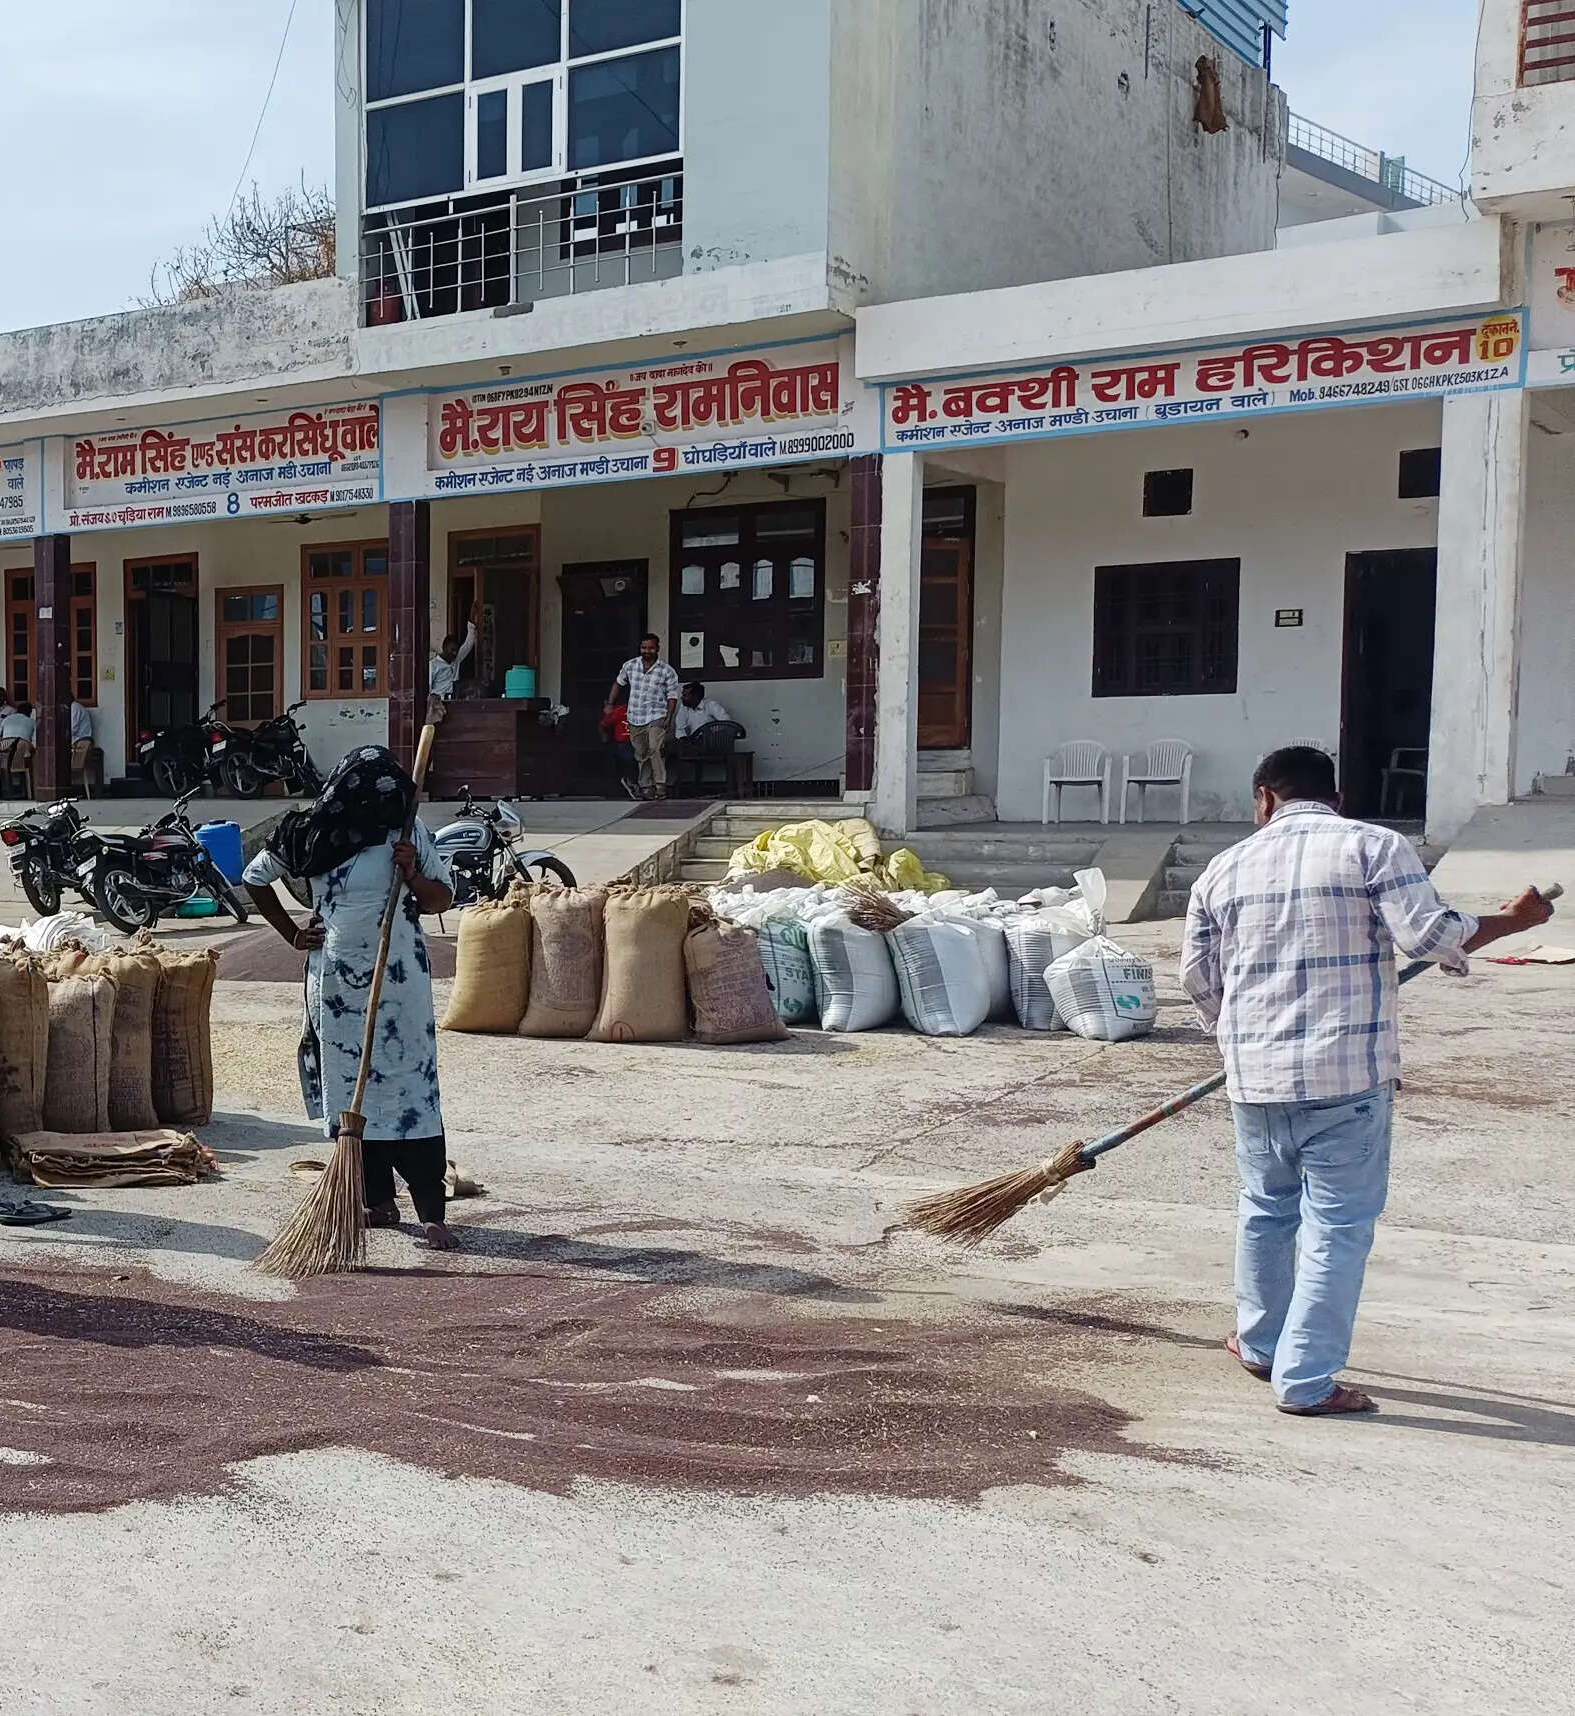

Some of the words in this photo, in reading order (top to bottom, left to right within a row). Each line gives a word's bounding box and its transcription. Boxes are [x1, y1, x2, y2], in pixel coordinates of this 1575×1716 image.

[1091, 362, 1180, 403] राम
[1195, 328, 1477, 394] हरिकिशन
[1479, 338, 1514, 361] 10
[554, 380, 647, 445] सिंह
[997, 416, 1045, 433] अनाज
[1049, 408, 1090, 428] मण्डी
[1092, 405, 1140, 423] उचाना
[139, 429, 191, 475] सिंह
[191, 441, 216, 469] एण्ड
[435, 471, 476, 490] कमीशन
[516, 463, 535, 484] नई
[536, 463, 577, 482] अनाज
[579, 455, 611, 477] मण्डी
[609, 454, 650, 474] उचाना
[652, 446, 679, 473] 9
[125, 477, 171, 495] कमीशन
[212, 468, 232, 488] नई
[236, 468, 274, 484] अनाज
[297, 461, 332, 477] उचाना
[147, 506, 166, 520] राम
[226, 492, 241, 515] 8
